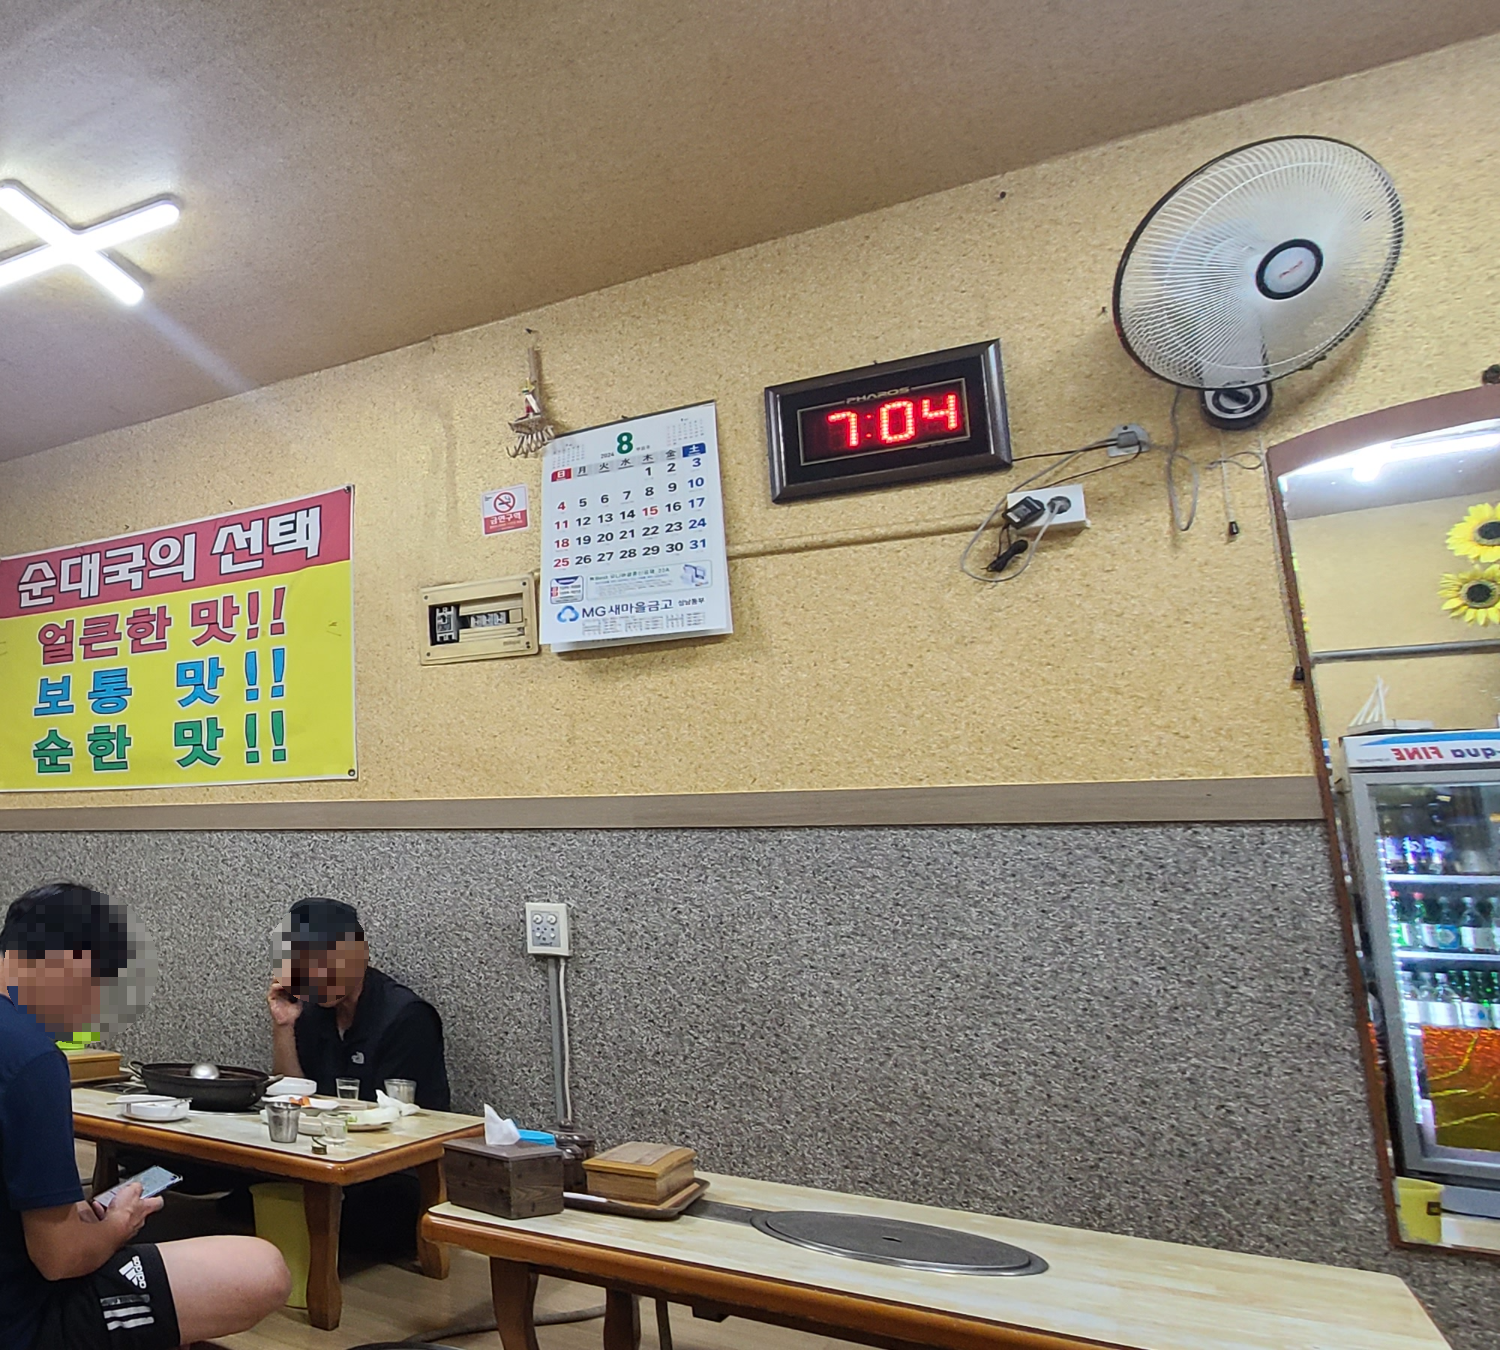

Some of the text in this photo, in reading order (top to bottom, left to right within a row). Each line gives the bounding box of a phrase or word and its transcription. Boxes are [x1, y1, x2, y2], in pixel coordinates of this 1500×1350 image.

[846, 386, 910, 405] PHAROS
[827, 393, 958, 448] 7:04
[616, 432, 633, 454] 8
[577, 466, 587, 474] 月
[600, 463, 609, 471] 火
[620, 458, 631, 466] 水
[643, 454, 654, 462] 木
[665, 450, 676, 458] 金
[645, 458, 701, 476] 1 2 3
[557, 477, 704, 510] 4 5 6 7 8 9 10
[490, 512, 521, 525] 금연구역
[554, 498, 705, 530] 11 12 13 14 15 16 17
[554, 518, 707, 548] 18 19 20 21 22 23 24
[18, 505, 322, 609] 순대국의 선택
[554, 539, 707, 568] 25 26 27 28 29 30 31
[582, 607, 606, 618] MG
[608, 599, 673, 615] 새마을금고
[38, 586, 287, 666] 얼큰한 맛!!
[33, 667, 132, 717] 보통
[33, 724, 132, 774] 순한
[132, 1255, 147, 1289] adidas
